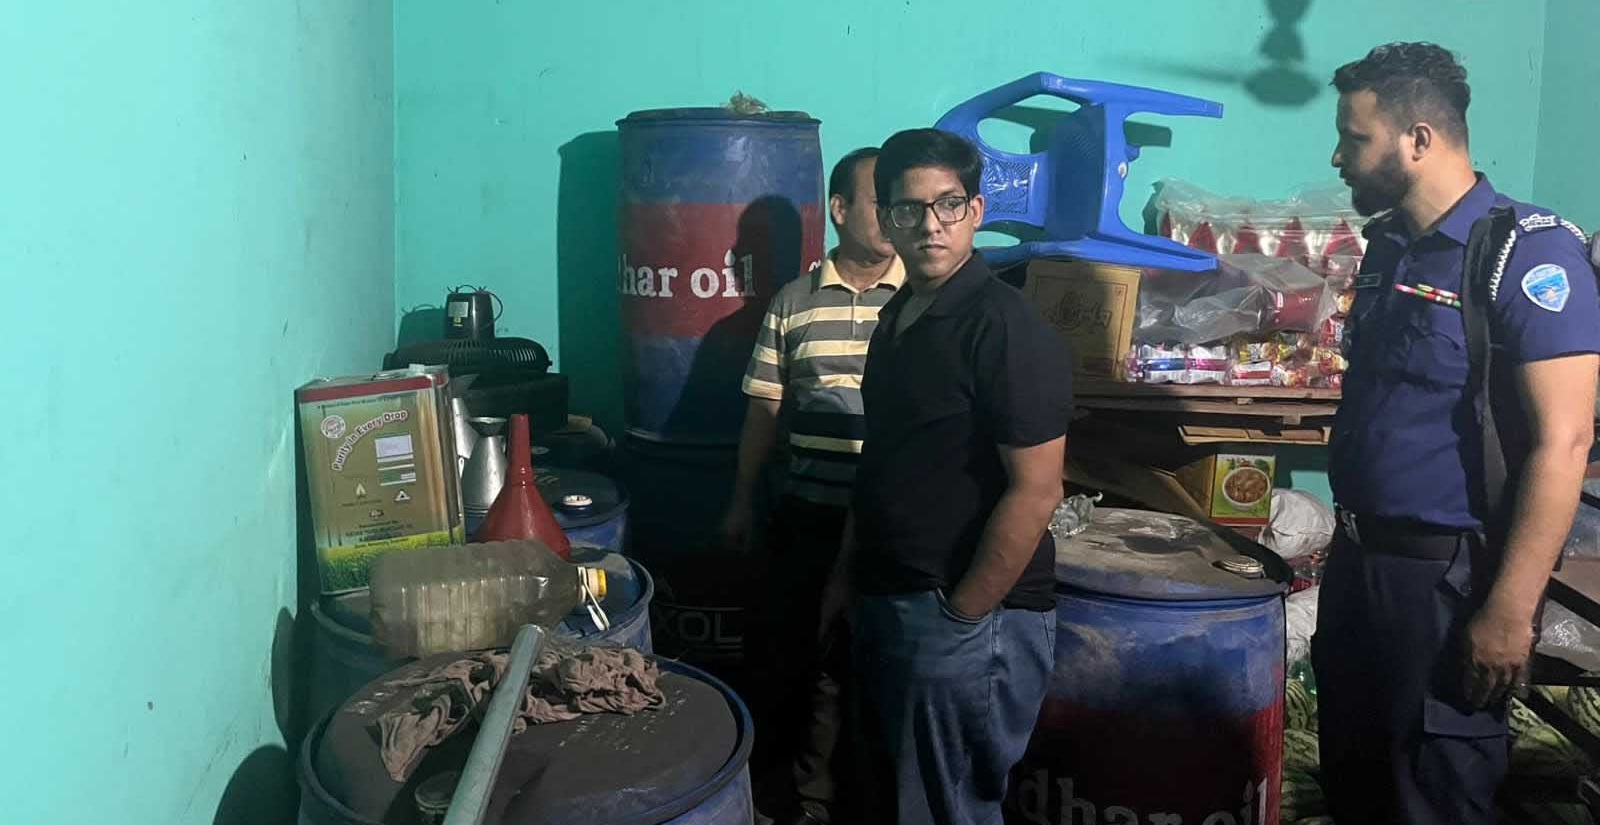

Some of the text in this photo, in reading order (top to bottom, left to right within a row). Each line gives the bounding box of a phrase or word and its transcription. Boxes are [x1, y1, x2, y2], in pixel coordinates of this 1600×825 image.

[616, 248, 756, 299] har oil
[333, 441, 352, 470] Purity
[357, 418, 383, 436] Every
[384, 411, 407, 422] Drop
[1016, 767, 1268, 825] dh il
